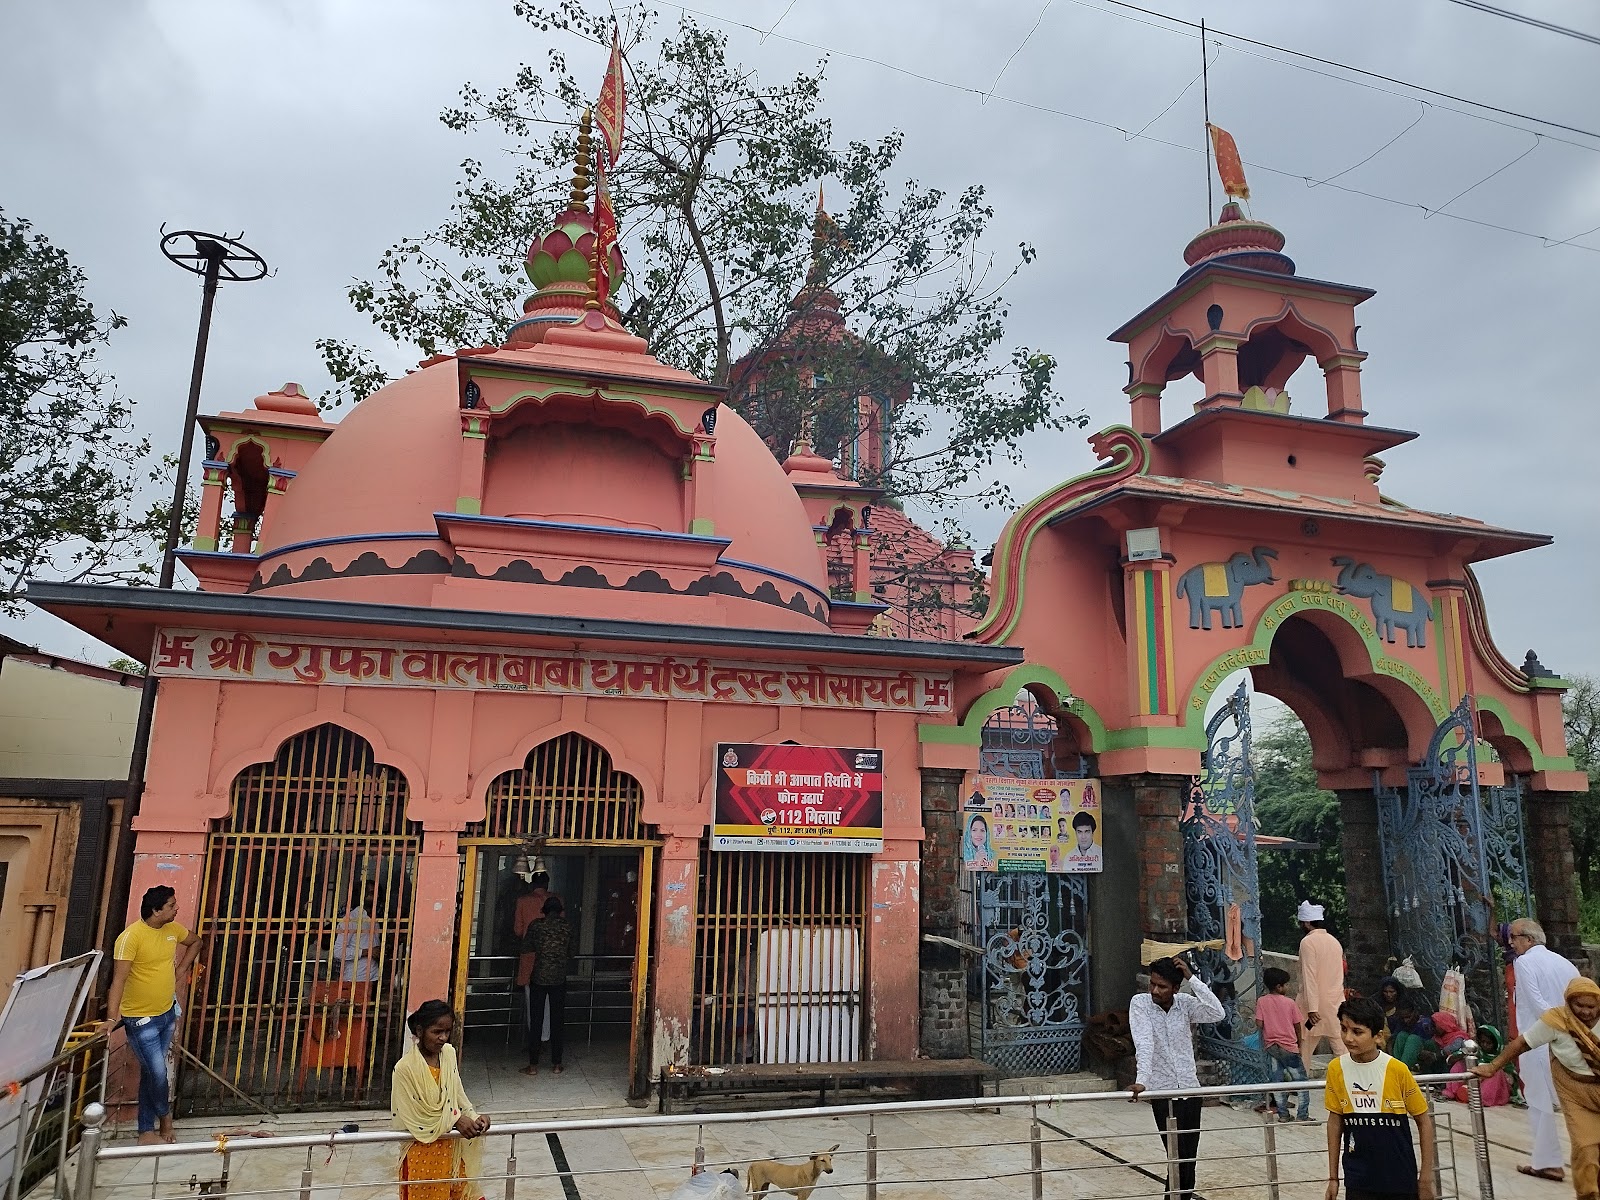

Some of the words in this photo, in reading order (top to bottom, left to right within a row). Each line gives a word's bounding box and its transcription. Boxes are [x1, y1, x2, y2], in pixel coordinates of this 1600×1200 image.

[1265, 615, 1276, 629] श्री
[1275, 597, 1296, 618] गुफा
[1301, 592, 1323, 605] वाले
[208, 632, 265, 676] श्री
[267, 640, 397, 684] गुफा
[401, 649, 500, 687] वाला
[501, 653, 586, 691] बाबा
[590, 657, 708, 697] धर्मार्थ
[710, 665, 784, 701] ट्रस्ट
[785, 664, 917, 708] सोसायटी
[746, 770, 772, 786] किसी
[775, 771, 787, 786] भी
[790, 773, 822, 788] आपात
[824, 772, 852, 788] स्थिति
[854, 773, 863, 788] में
[778, 789, 799, 805] फोन
[778, 809, 802, 825] 112
[805, 807, 842, 825] मिलाएं
[1355, 1098, 1376, 1108] UM
[1344, 1117, 1376, 1126] SPORTS
[1379, 1117, 1400, 1127] CLUB
